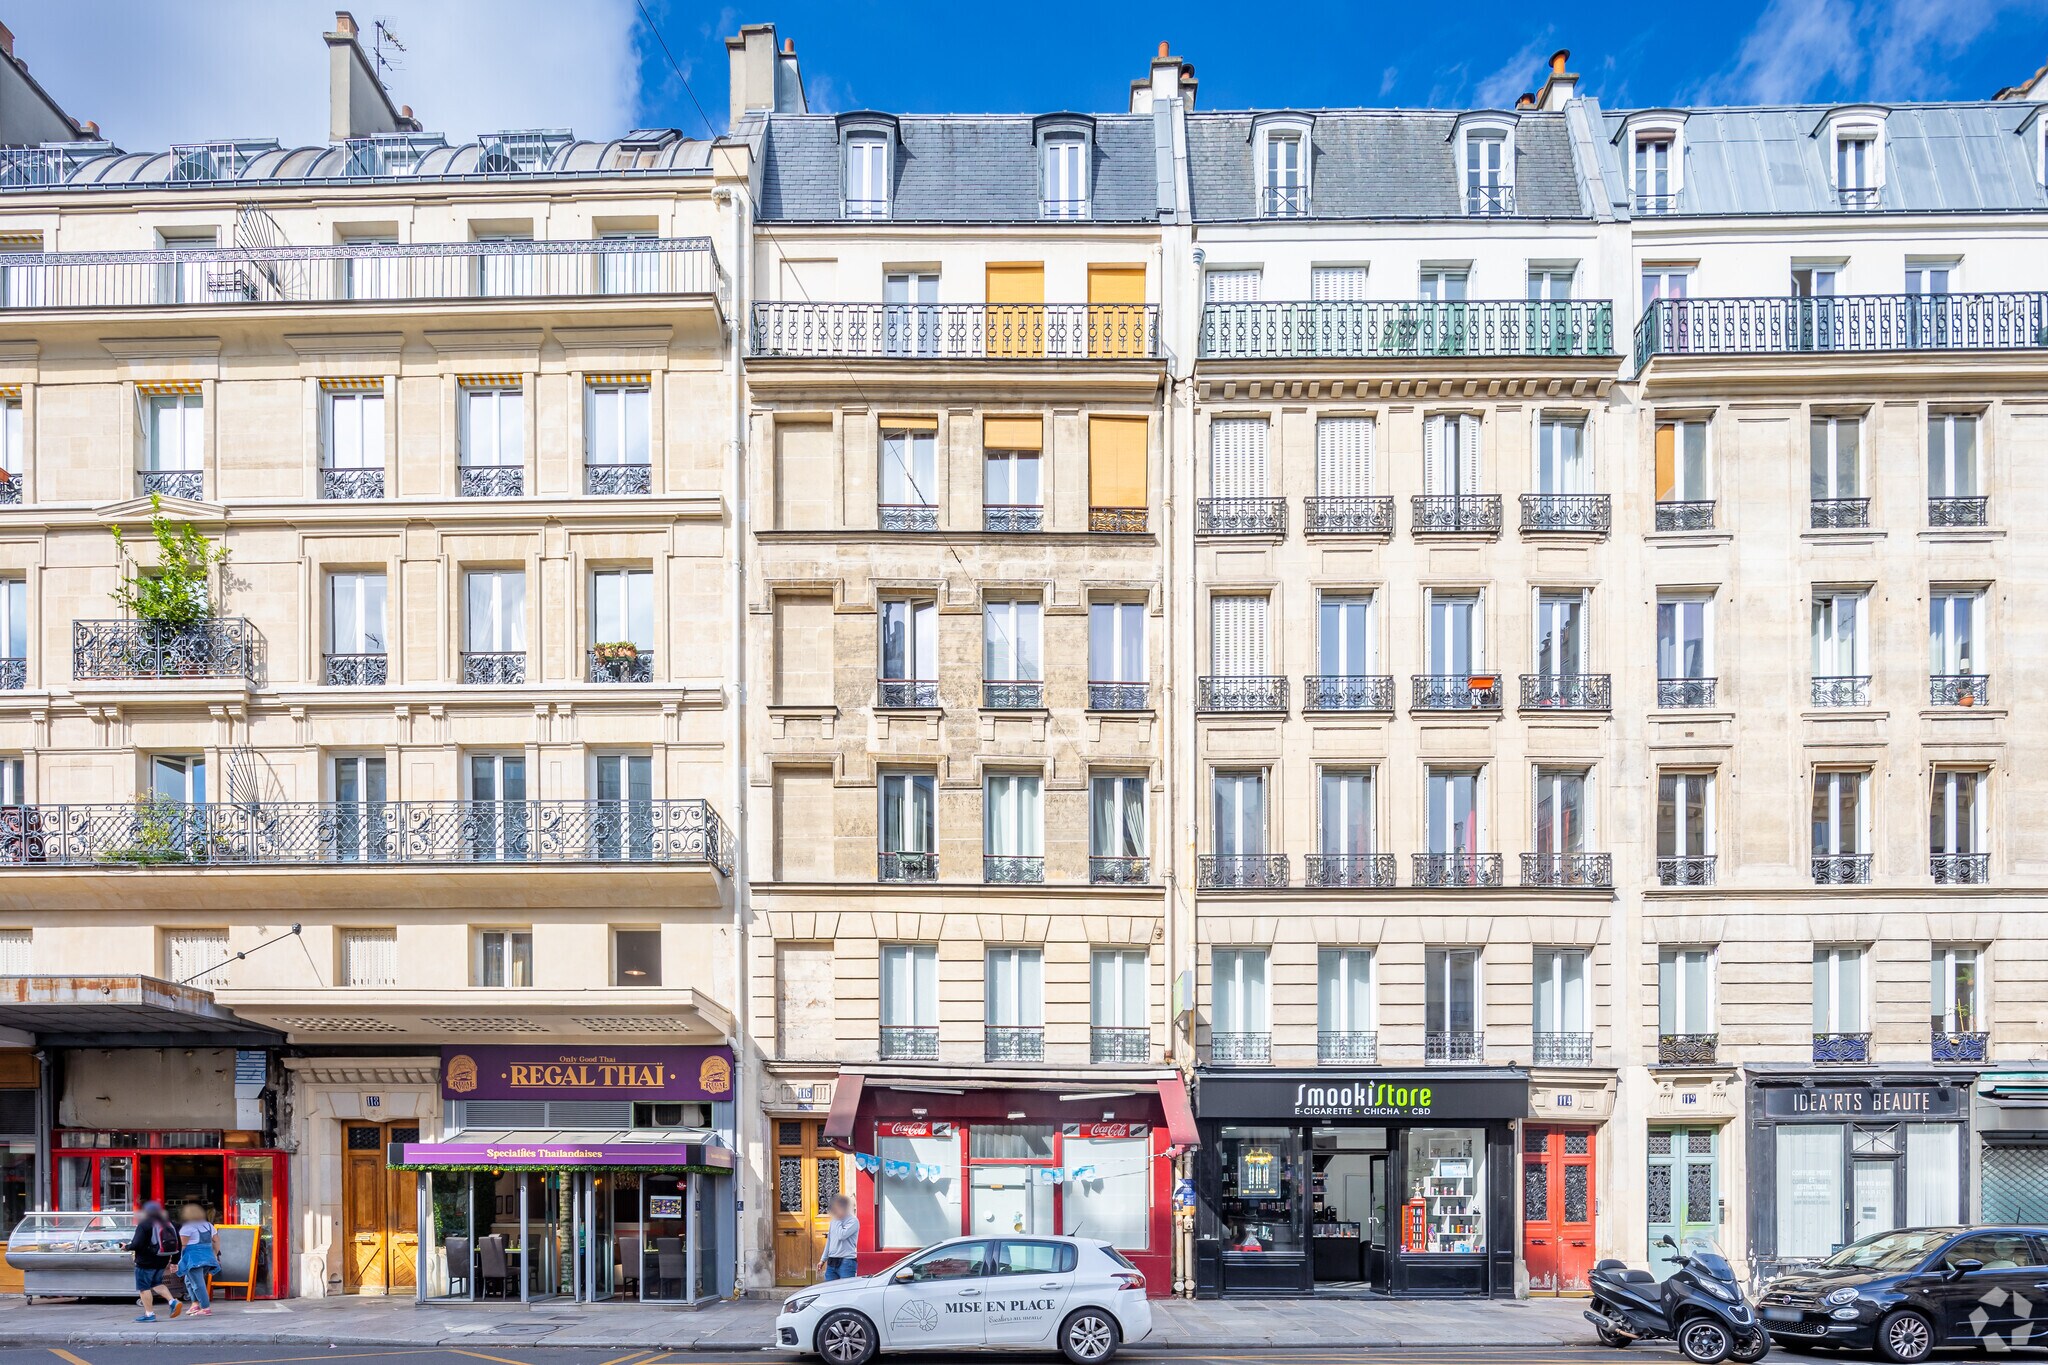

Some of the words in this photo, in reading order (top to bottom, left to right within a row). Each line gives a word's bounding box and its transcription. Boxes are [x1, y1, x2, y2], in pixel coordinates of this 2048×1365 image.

[559, 1055, 577, 1064] Only
[579, 1055, 597, 1063] Good
[510, 1065, 596, 1086] REGAL
[799, 1088, 812, 1098] 116
[367, 1096, 379, 1106] 118
[1559, 1095, 1572, 1106] 114
[1683, 1094, 1696, 1104] 112
[1793, 1093, 1862, 1111] IDEA'RTS
[1873, 1092, 1930, 1111] BEAUTE
[1294, 1107, 1353, 1115] E-CIGARETTE
[1363, 1107, 1400, 1115] CHICHA
[1411, 1107, 1431, 1115] CBD
[945, 1302, 982, 1314] MISE
[986, 1301, 1006, 1312] EN
[1010, 1299, 1056, 1311] PLACE
